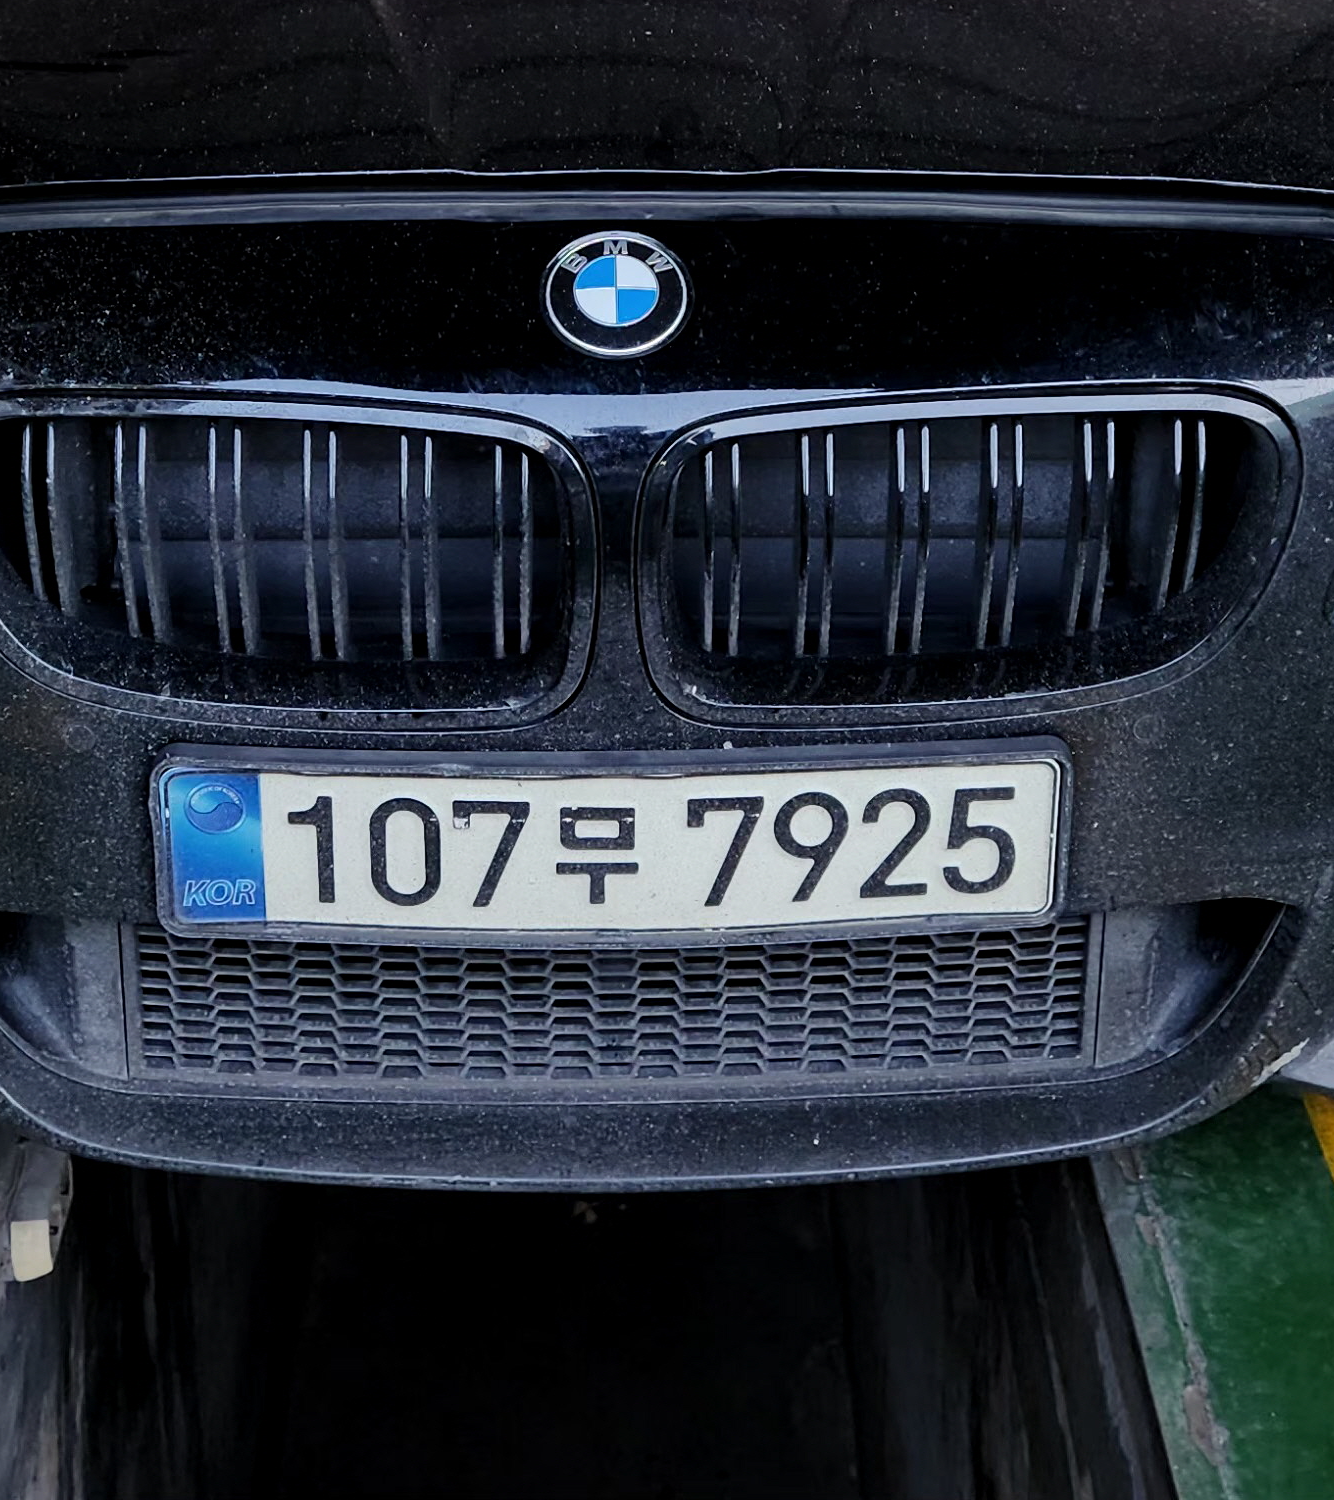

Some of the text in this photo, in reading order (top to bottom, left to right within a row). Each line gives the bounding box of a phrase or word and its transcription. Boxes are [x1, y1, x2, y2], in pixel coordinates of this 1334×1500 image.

[560, 239, 674, 274] BMW
[286, 786, 1017, 908] 107무 7925
[183, 879, 256, 907] KOR
